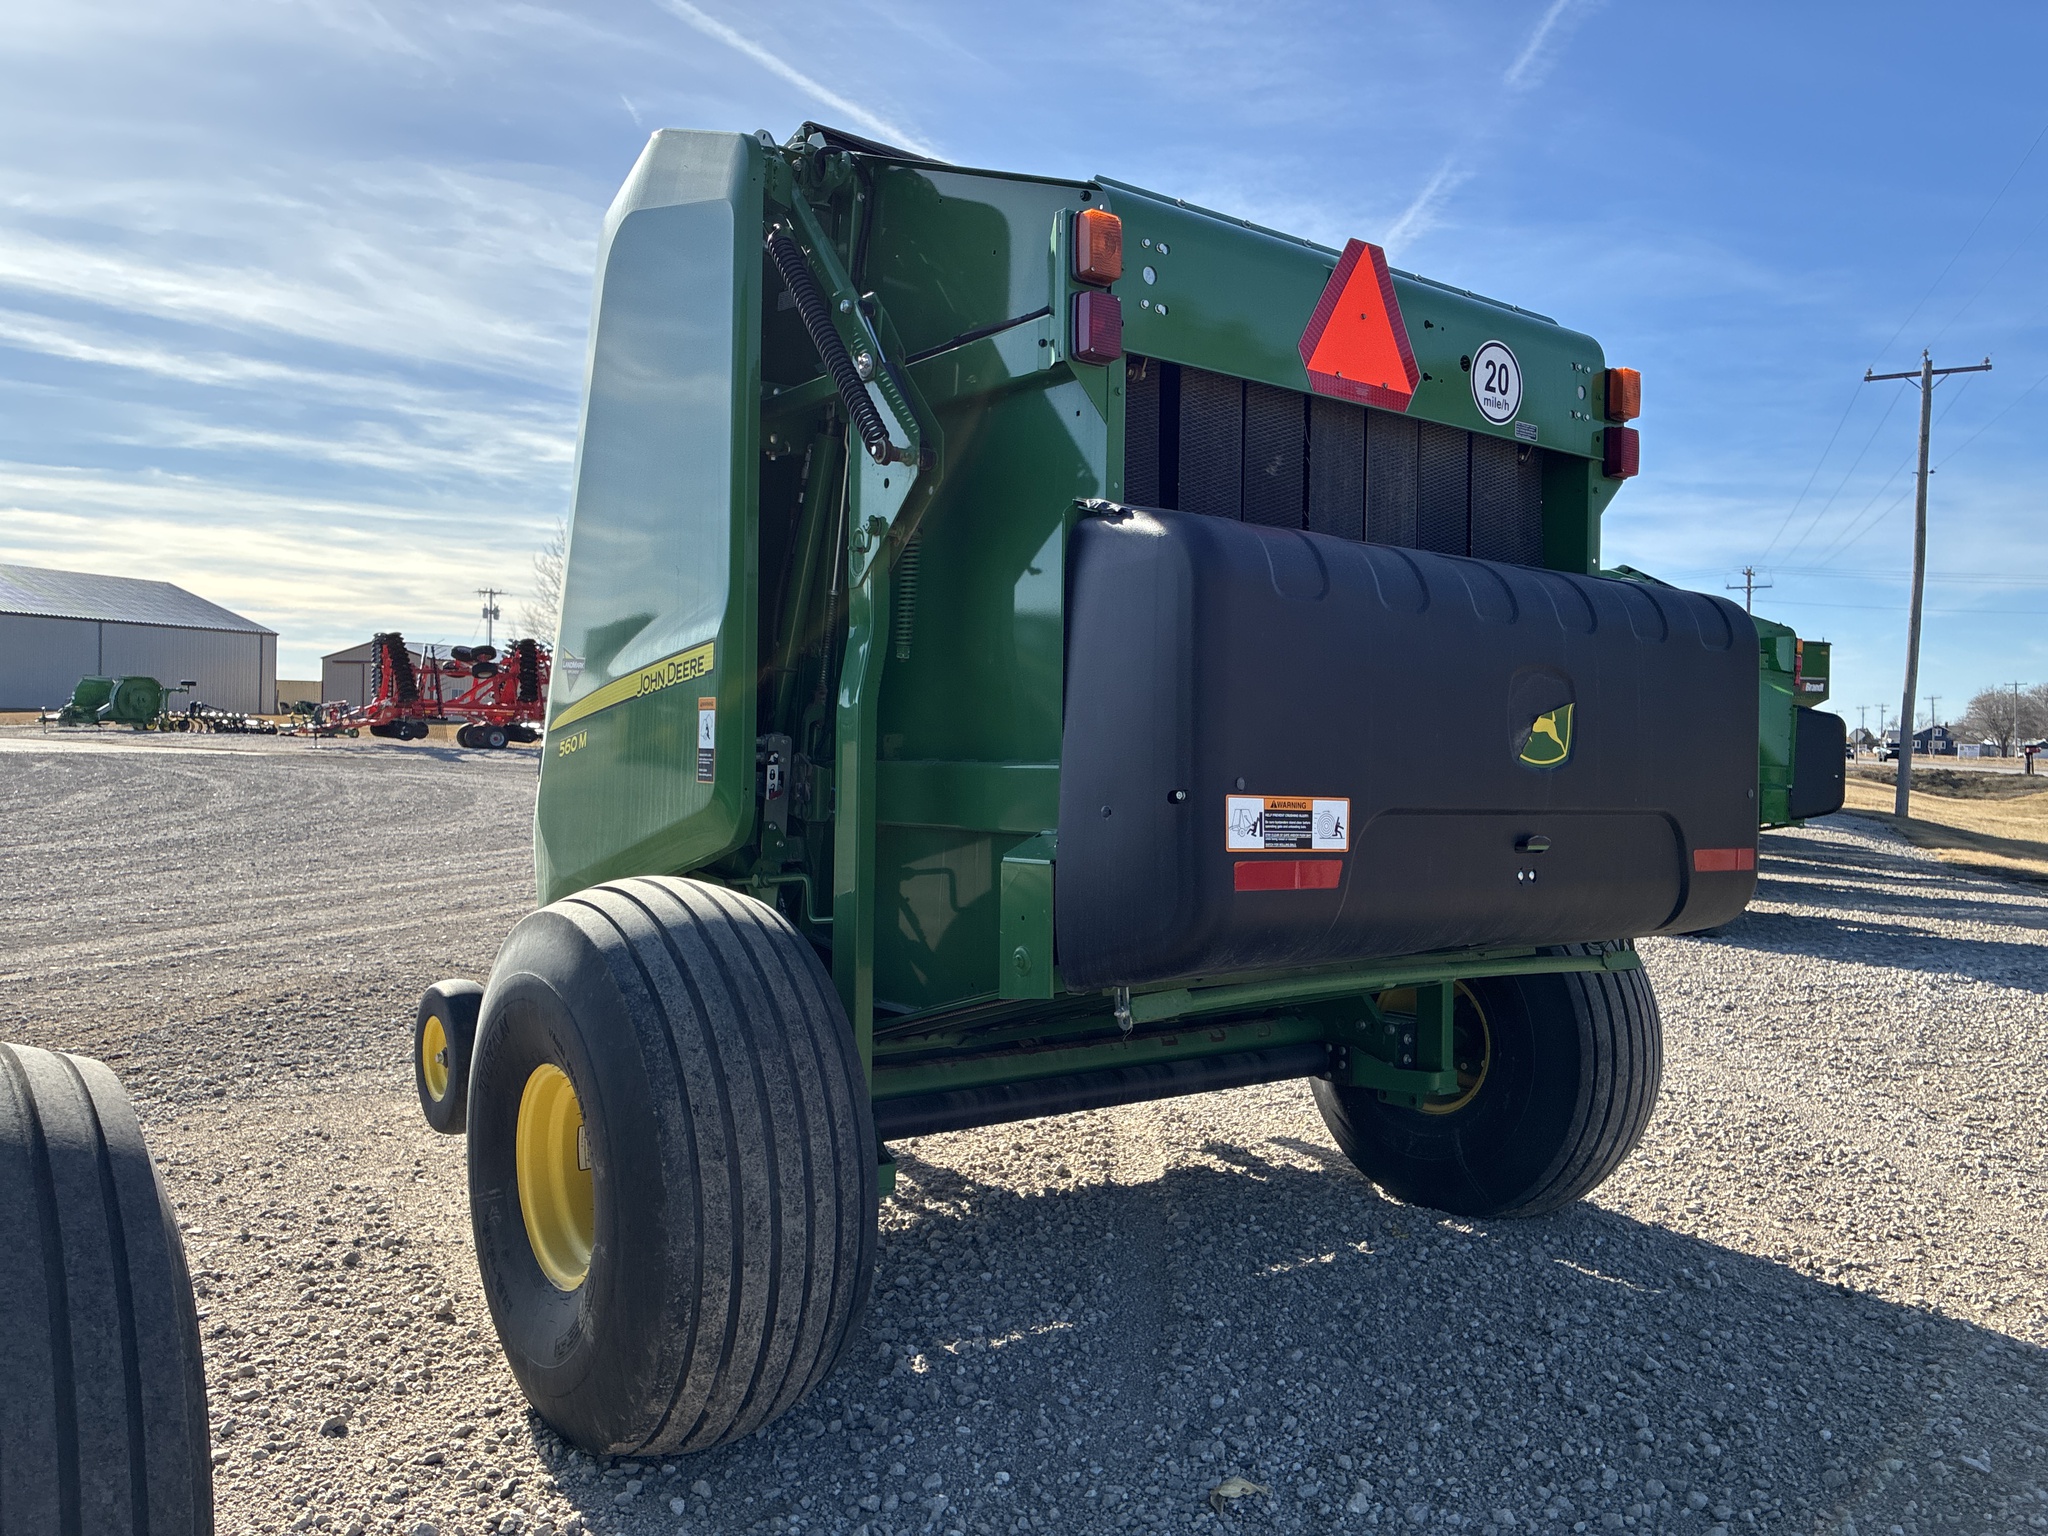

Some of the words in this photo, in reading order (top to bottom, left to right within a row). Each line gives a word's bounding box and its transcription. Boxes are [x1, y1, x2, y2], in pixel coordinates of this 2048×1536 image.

[1484, 359, 1510, 396] 20
[1483, 396, 1510, 412] mile/h
[636, 668, 665, 695] JOHN
[667, 654, 705, 684] DEERE
[558, 735, 578, 758] 560
[578, 731, 588, 750] M
[1276, 801, 1307, 810] WARNING
